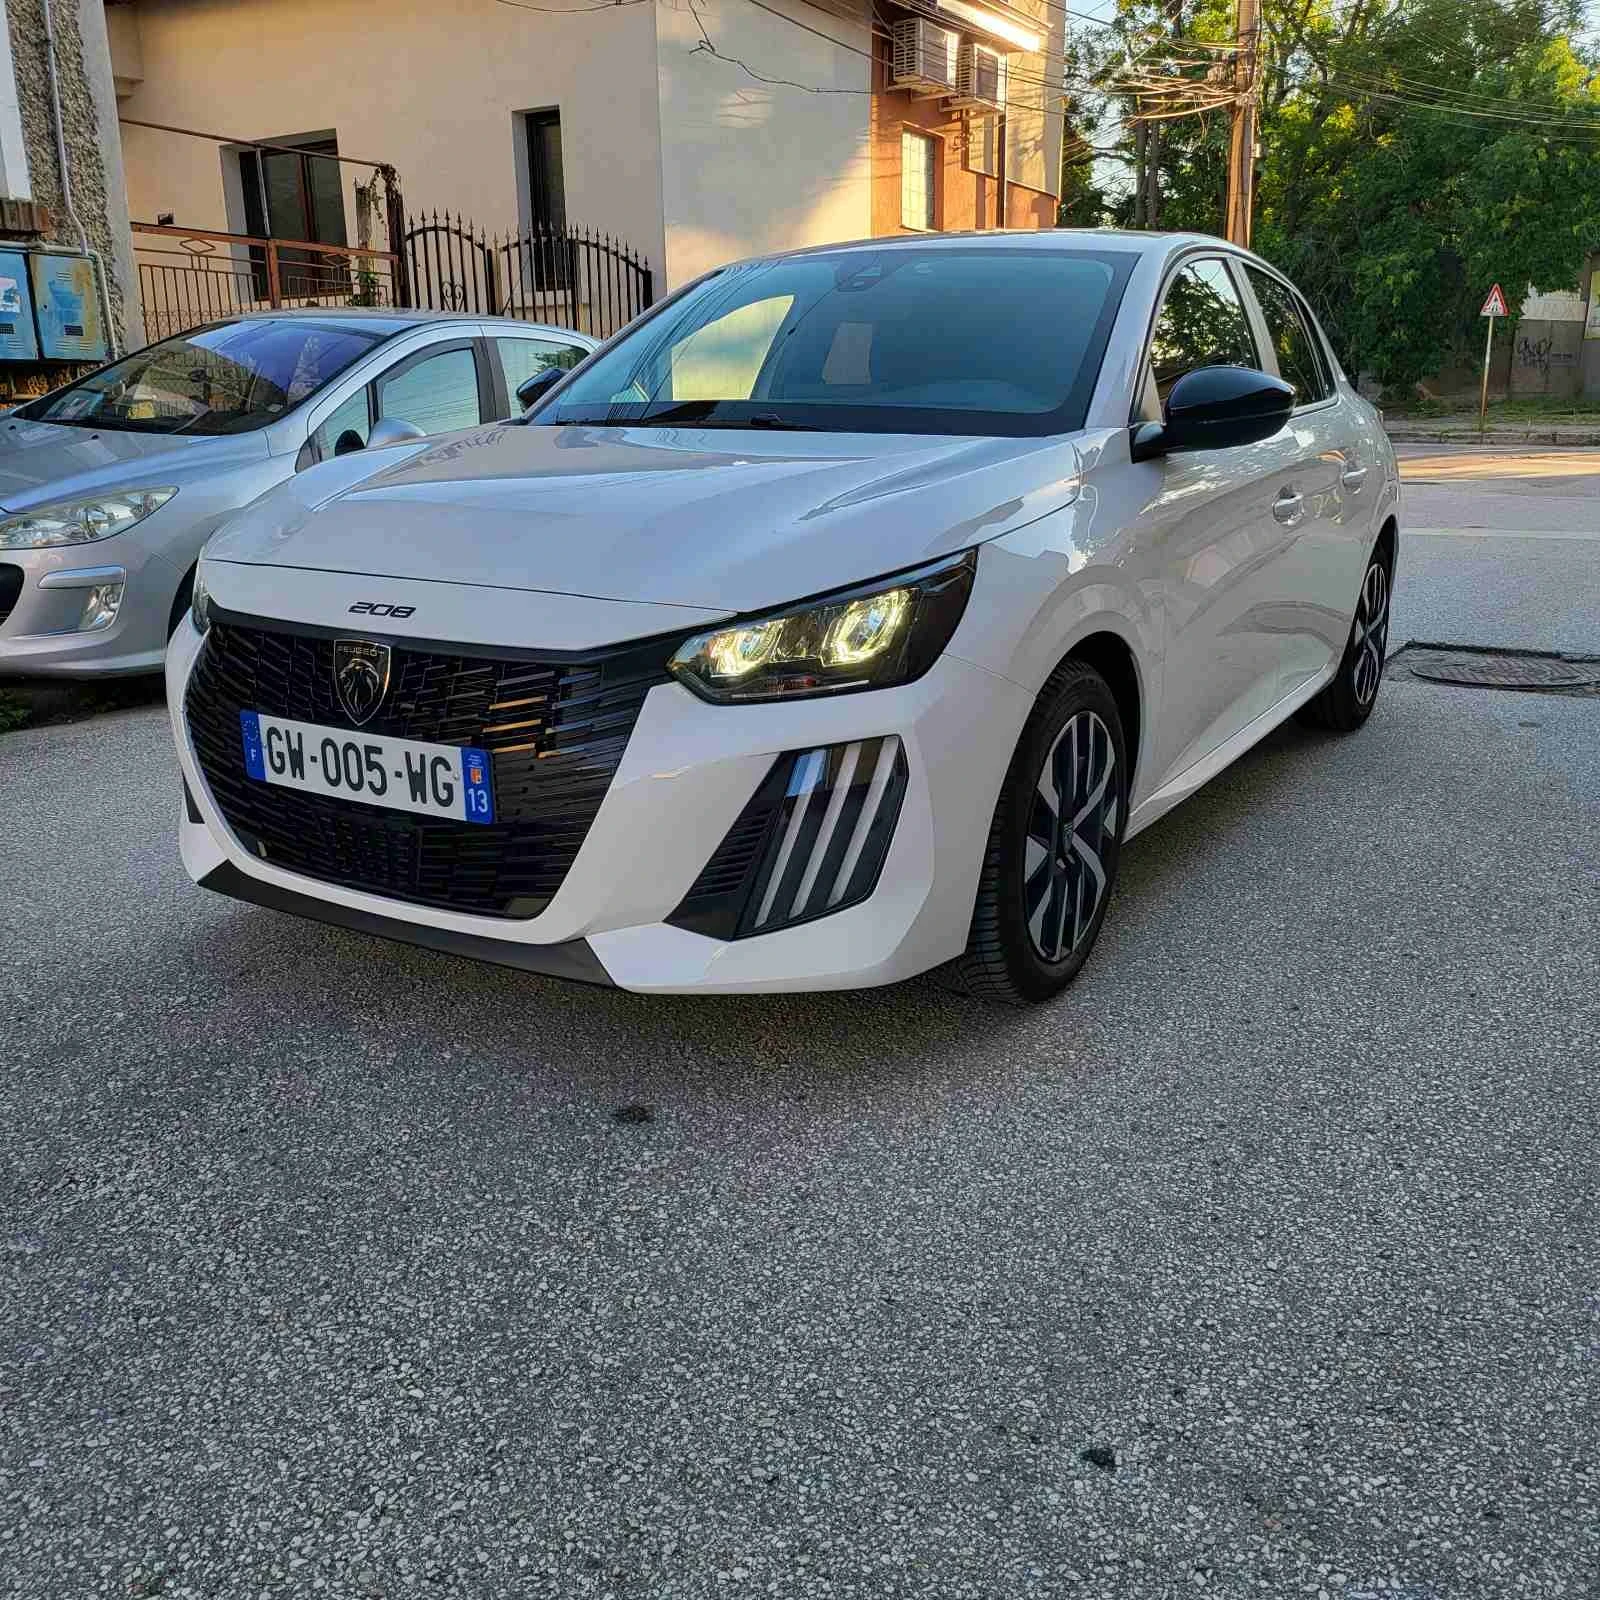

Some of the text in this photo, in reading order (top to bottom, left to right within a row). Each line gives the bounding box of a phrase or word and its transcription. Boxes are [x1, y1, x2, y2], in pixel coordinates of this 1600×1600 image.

[348, 601, 416, 618] 208
[266, 726, 454, 808] GW-005-WG
[467, 788, 488, 813] 13
